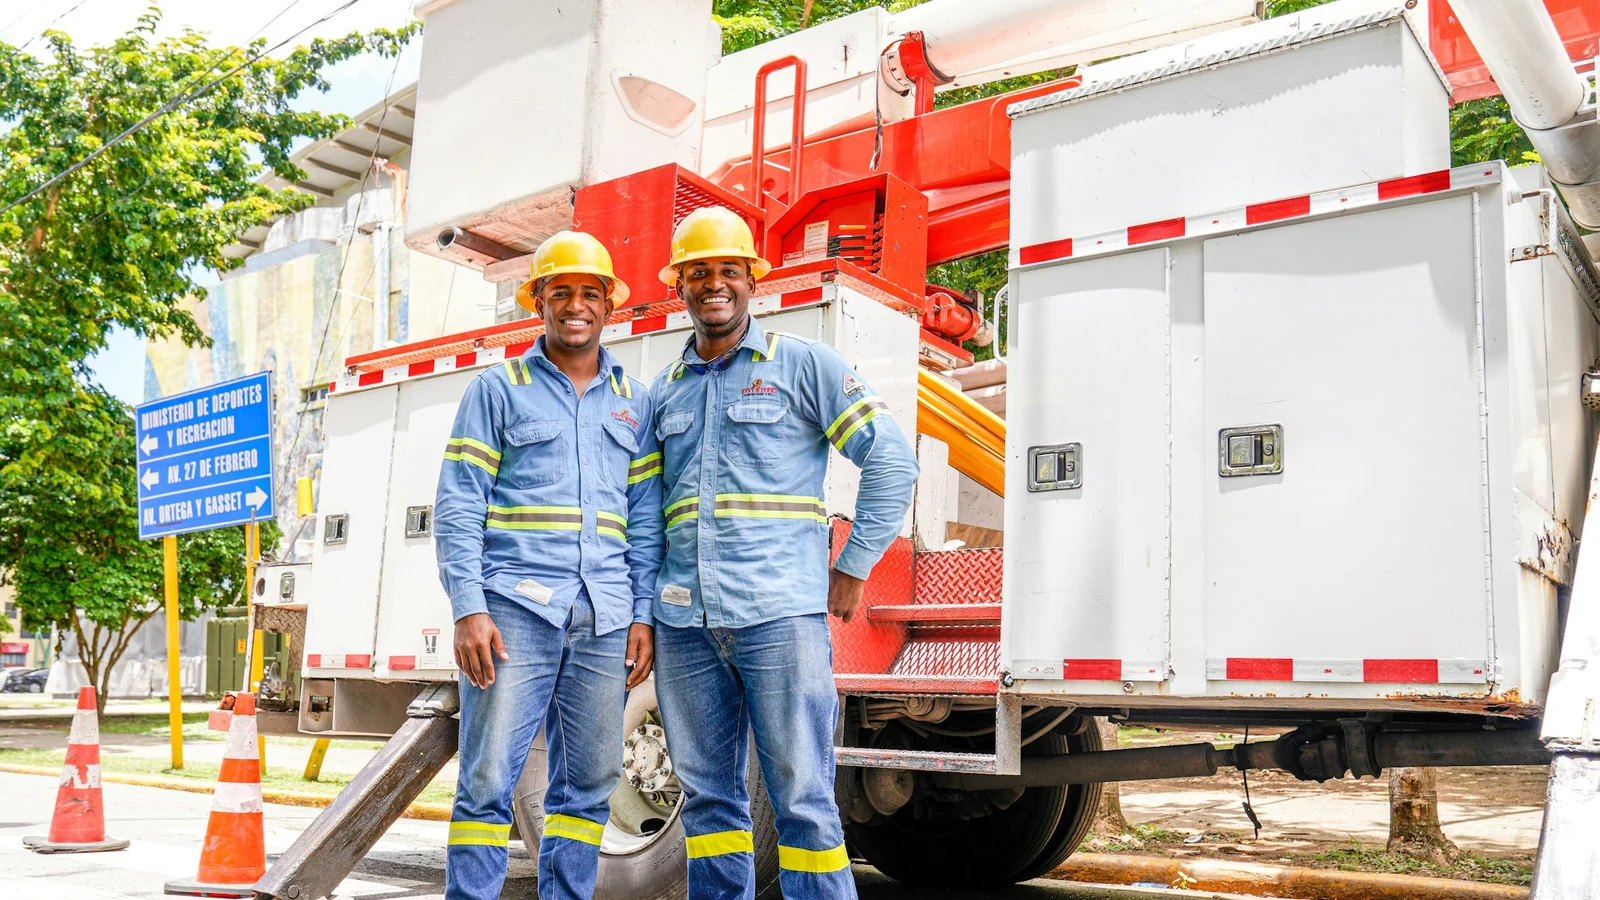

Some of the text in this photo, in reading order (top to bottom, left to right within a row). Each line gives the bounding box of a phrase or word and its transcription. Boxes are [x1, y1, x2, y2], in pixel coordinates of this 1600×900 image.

[141, 384, 262, 430] MINISTERIO DE DEPORTES
[167, 416, 235, 448] Y RECREACION
[168, 449, 258, 484] AV. 27 DE FEBRERO
[143, 492, 243, 526] AV. ORTEGA Y GASSET
